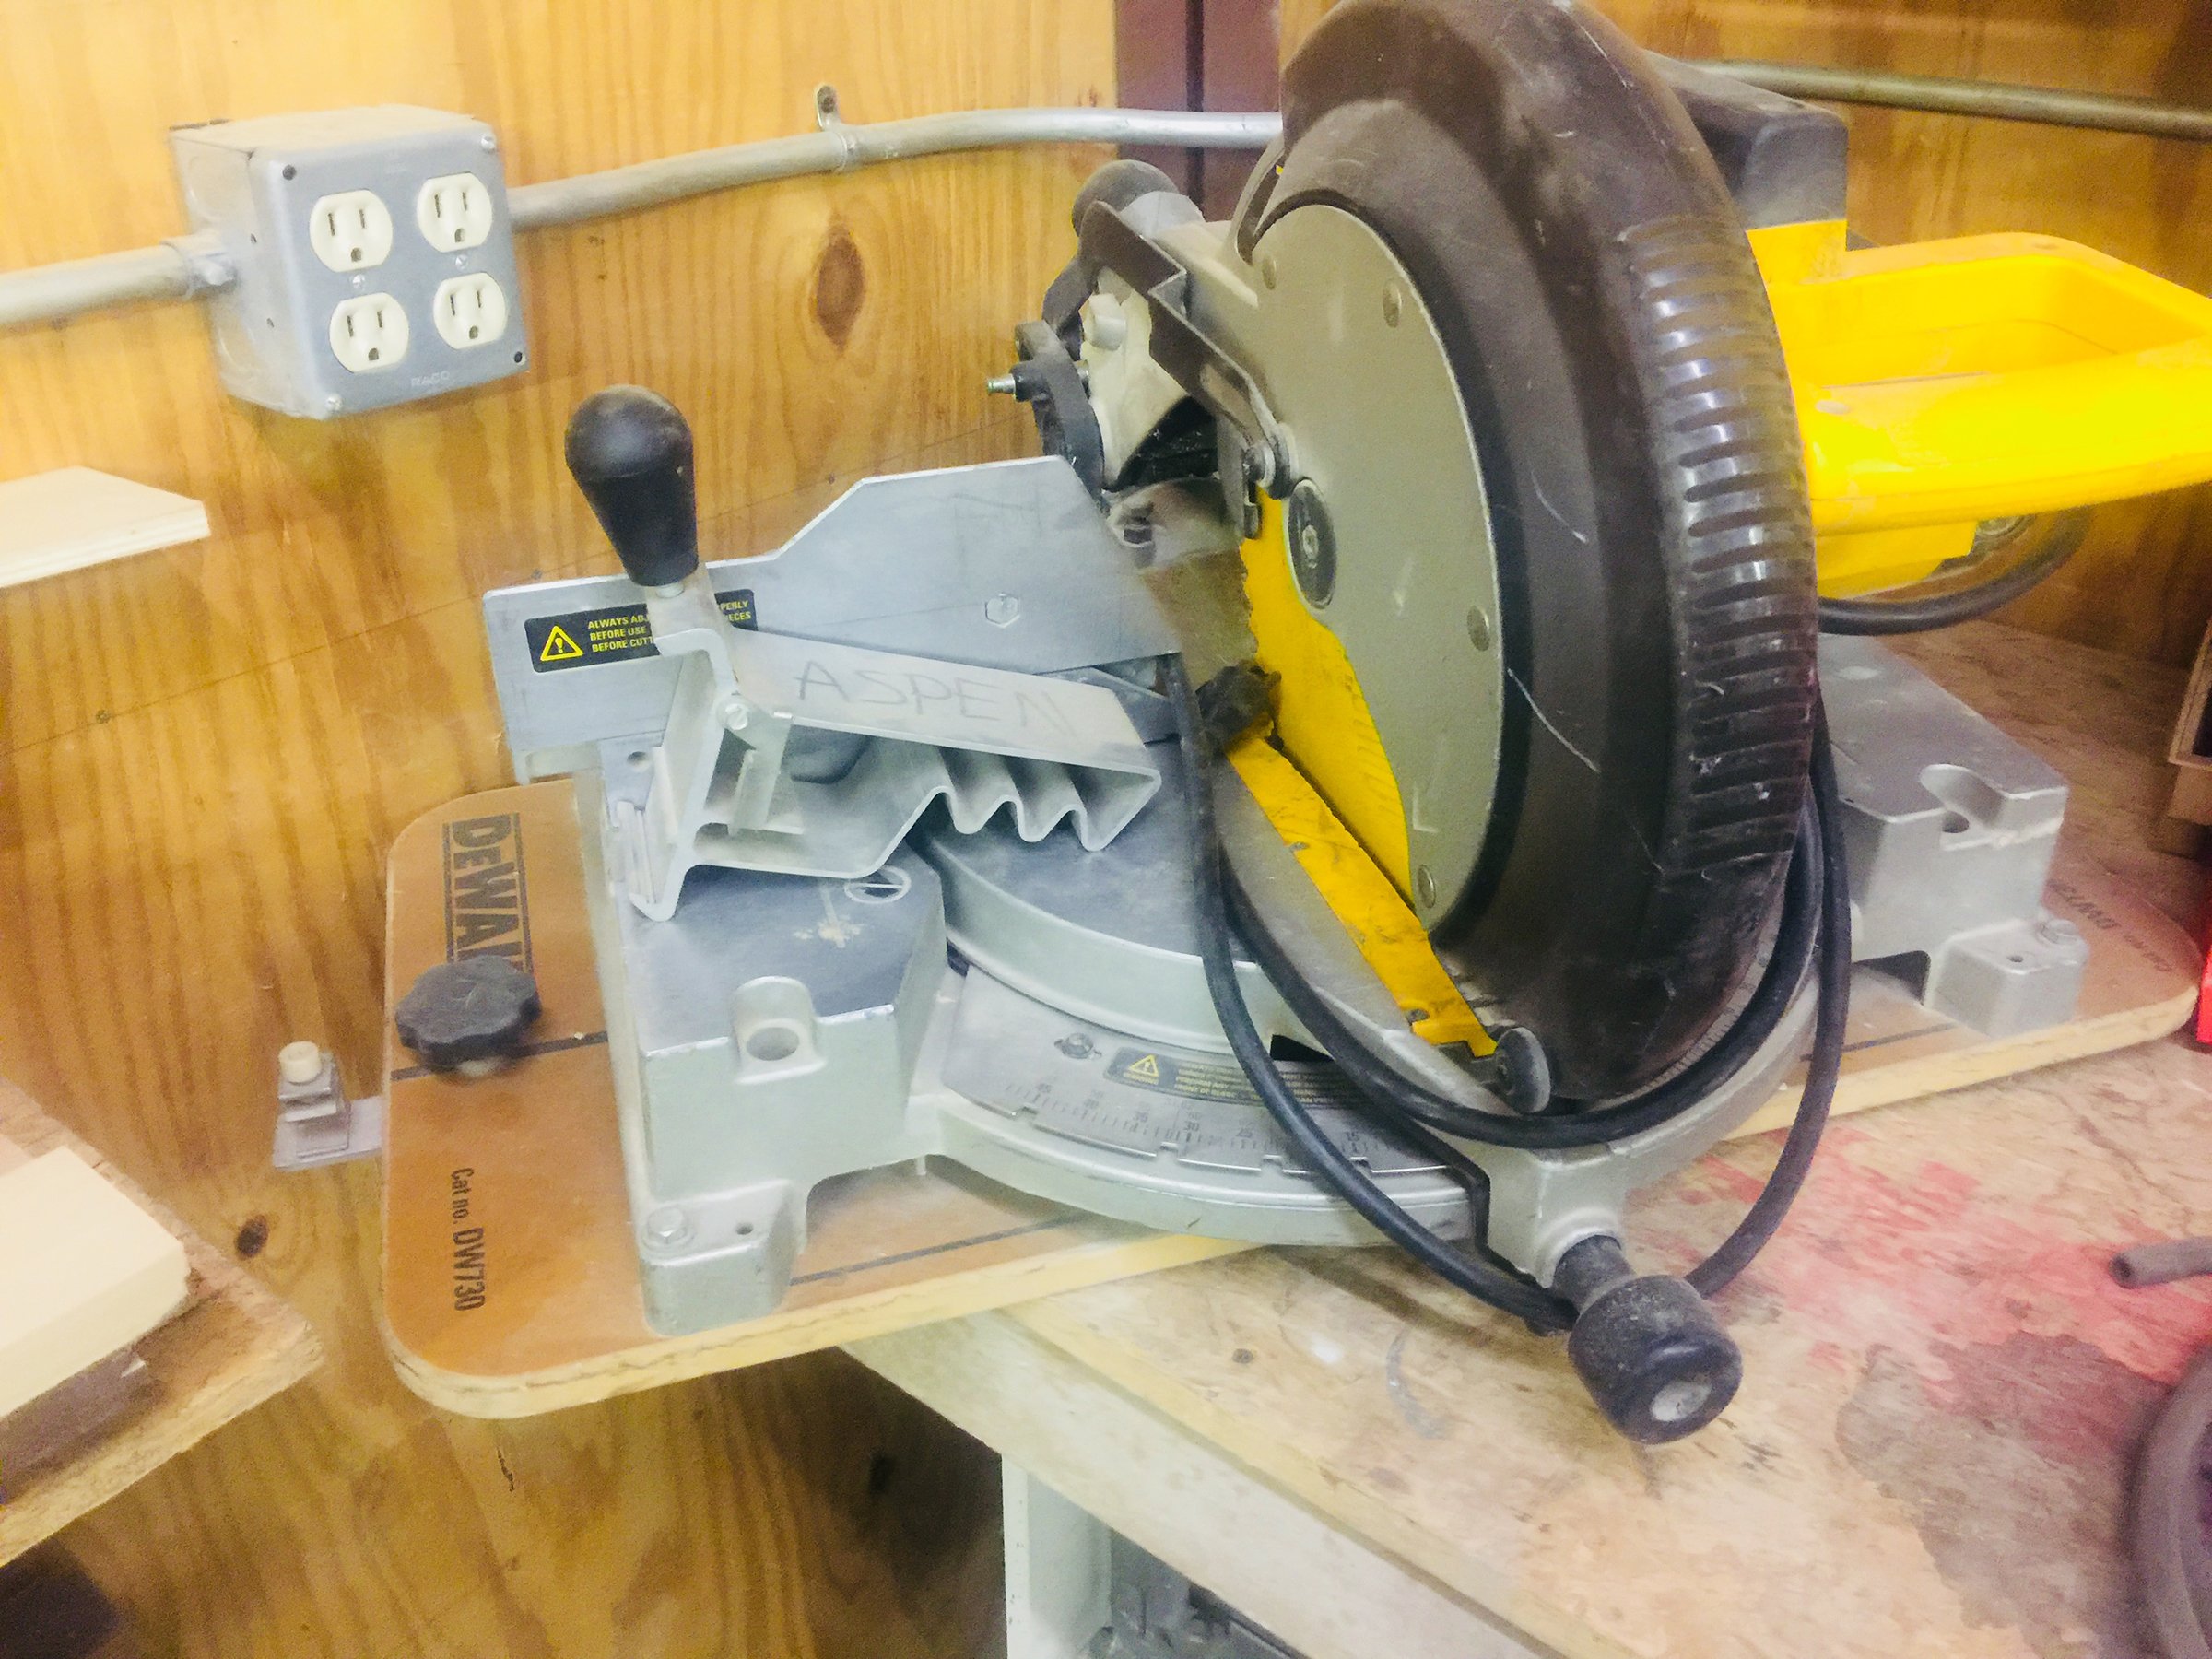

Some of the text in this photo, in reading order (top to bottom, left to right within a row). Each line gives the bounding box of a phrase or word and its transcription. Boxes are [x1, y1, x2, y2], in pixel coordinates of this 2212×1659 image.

[588, 600, 748, 629] ALWAYS ADJ PERLY
[590, 629, 626, 641] BEFORE
[728, 611, 752, 622] ECES
[592, 636, 653, 653] BEFORE CUTT
[794, 660, 1077, 737] ASPEN
[451, 1168, 486, 1312] Cat no. DW730
